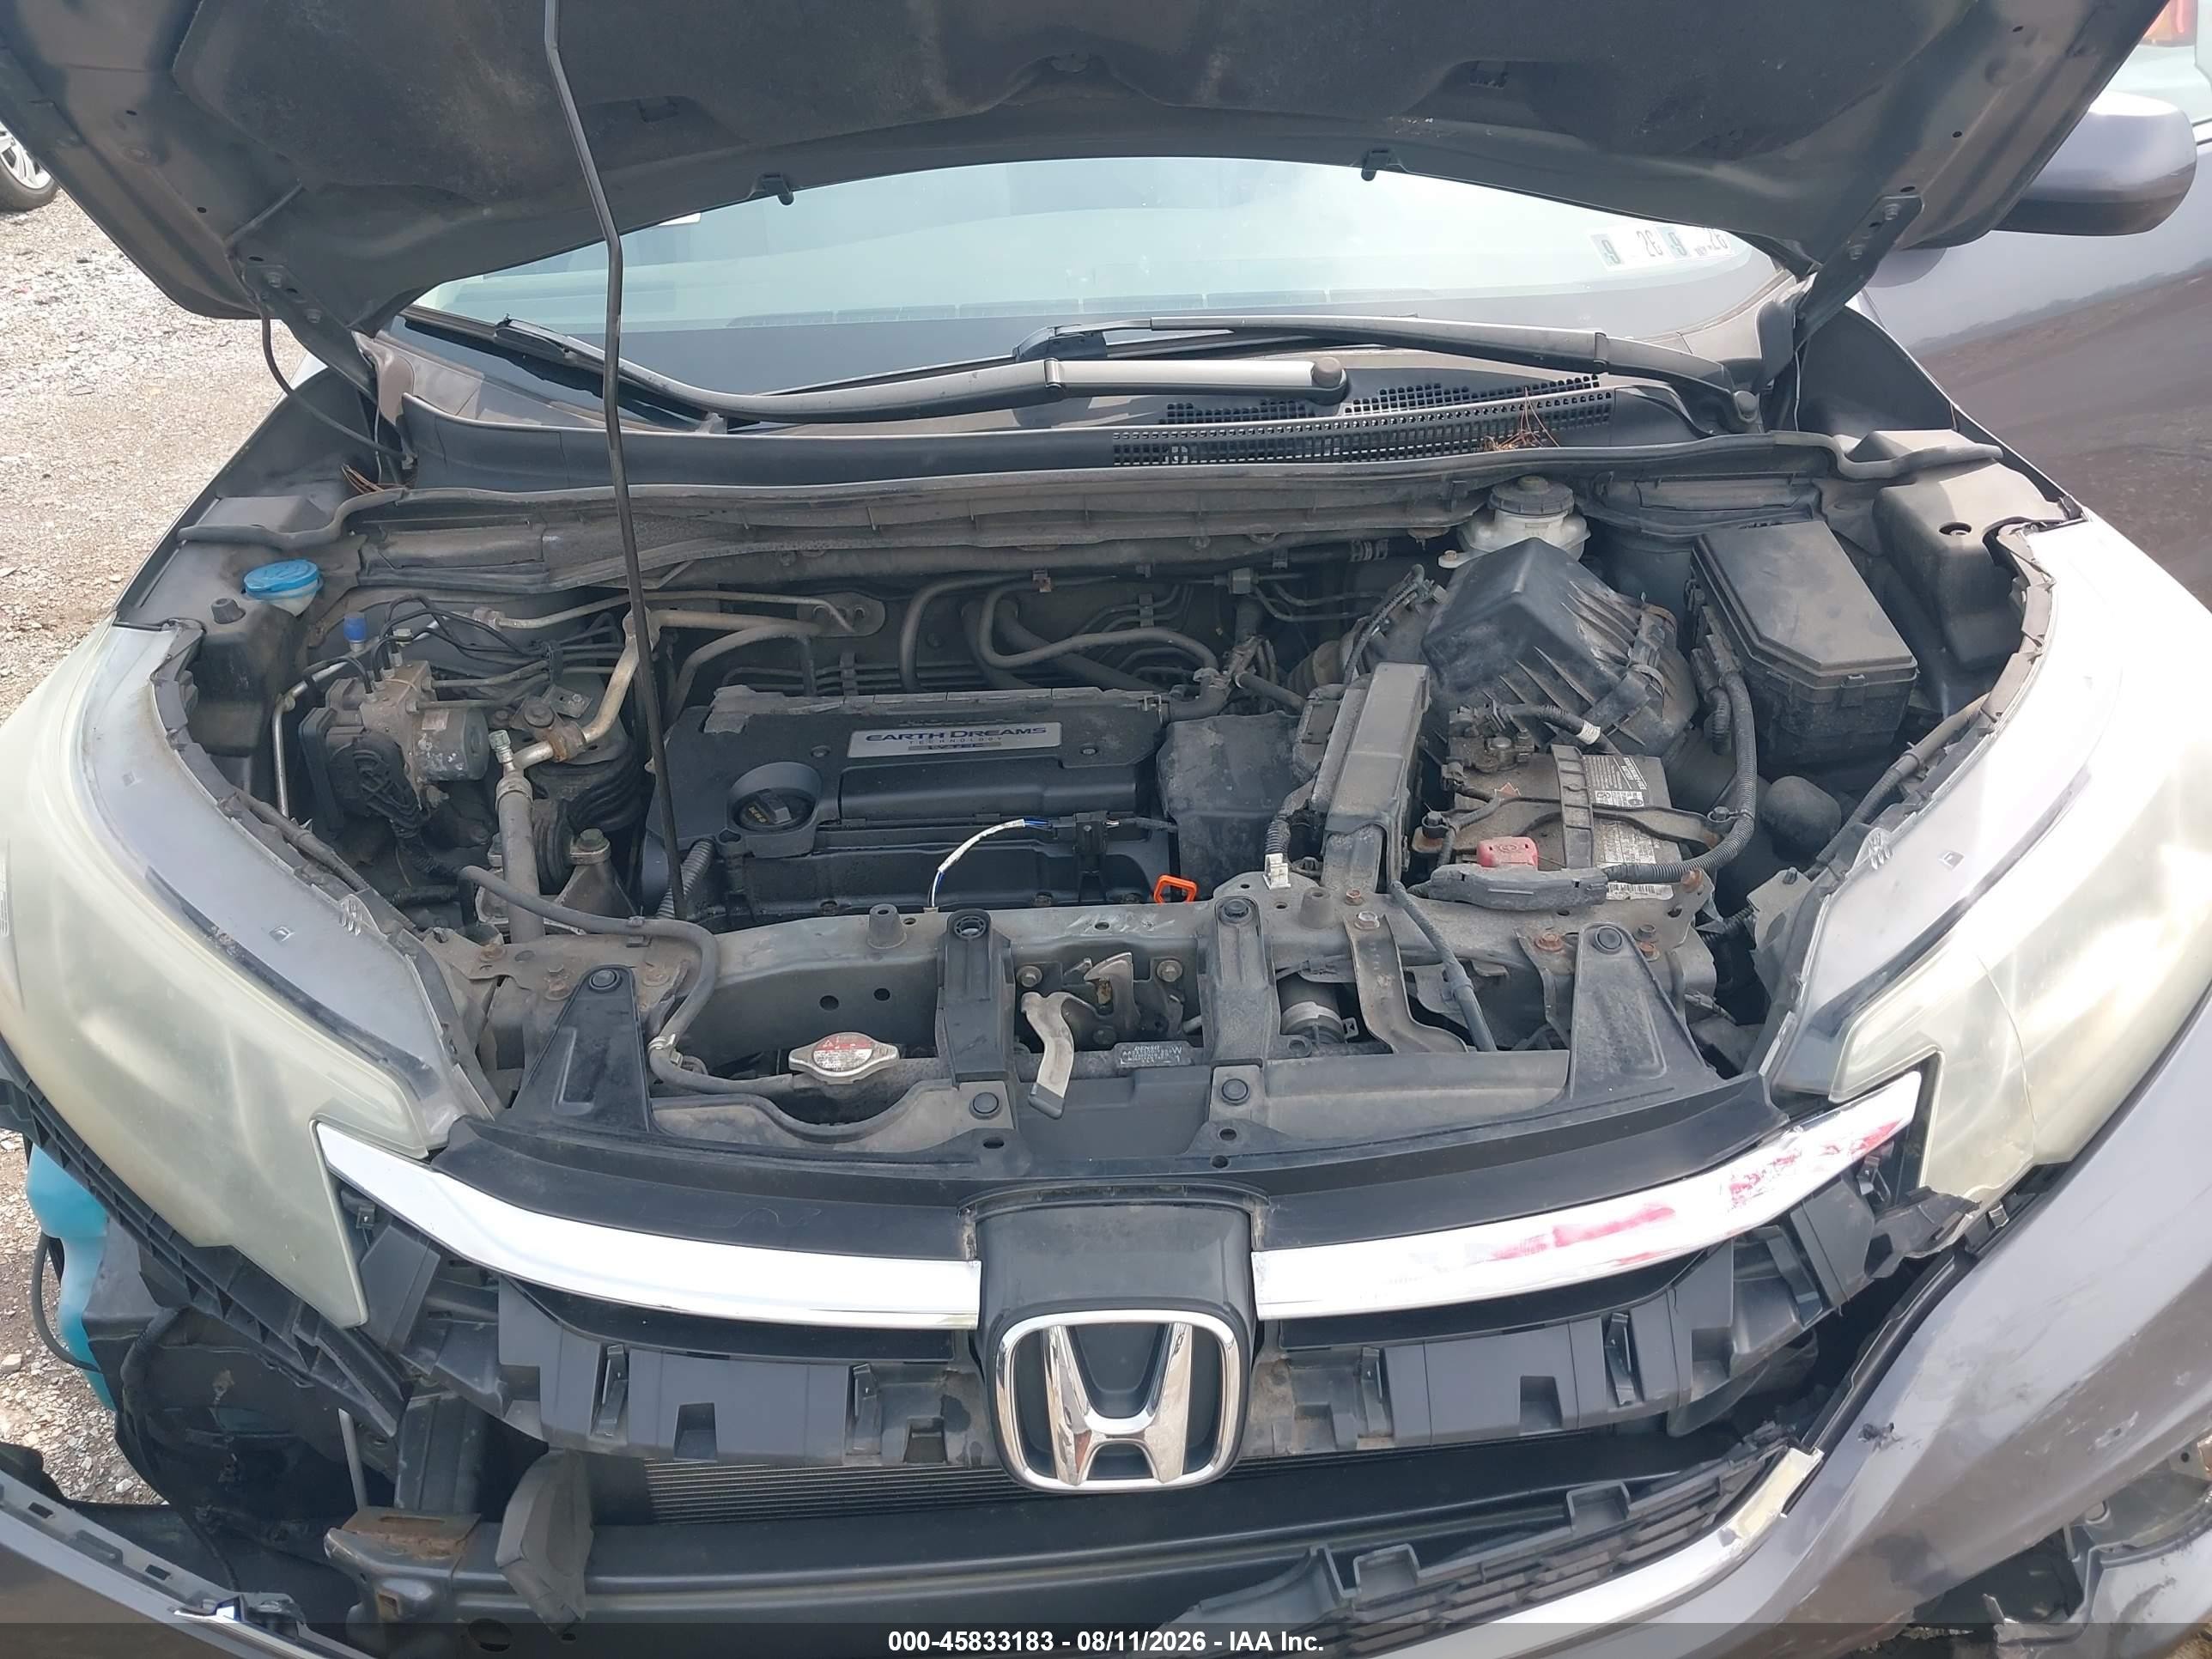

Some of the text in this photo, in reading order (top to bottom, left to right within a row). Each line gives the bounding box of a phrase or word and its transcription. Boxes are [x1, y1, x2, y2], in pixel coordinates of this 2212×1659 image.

[866, 726, 1047, 742] EARTH DREAMS
[908, 736, 1003, 744] TECHNOLOGY
